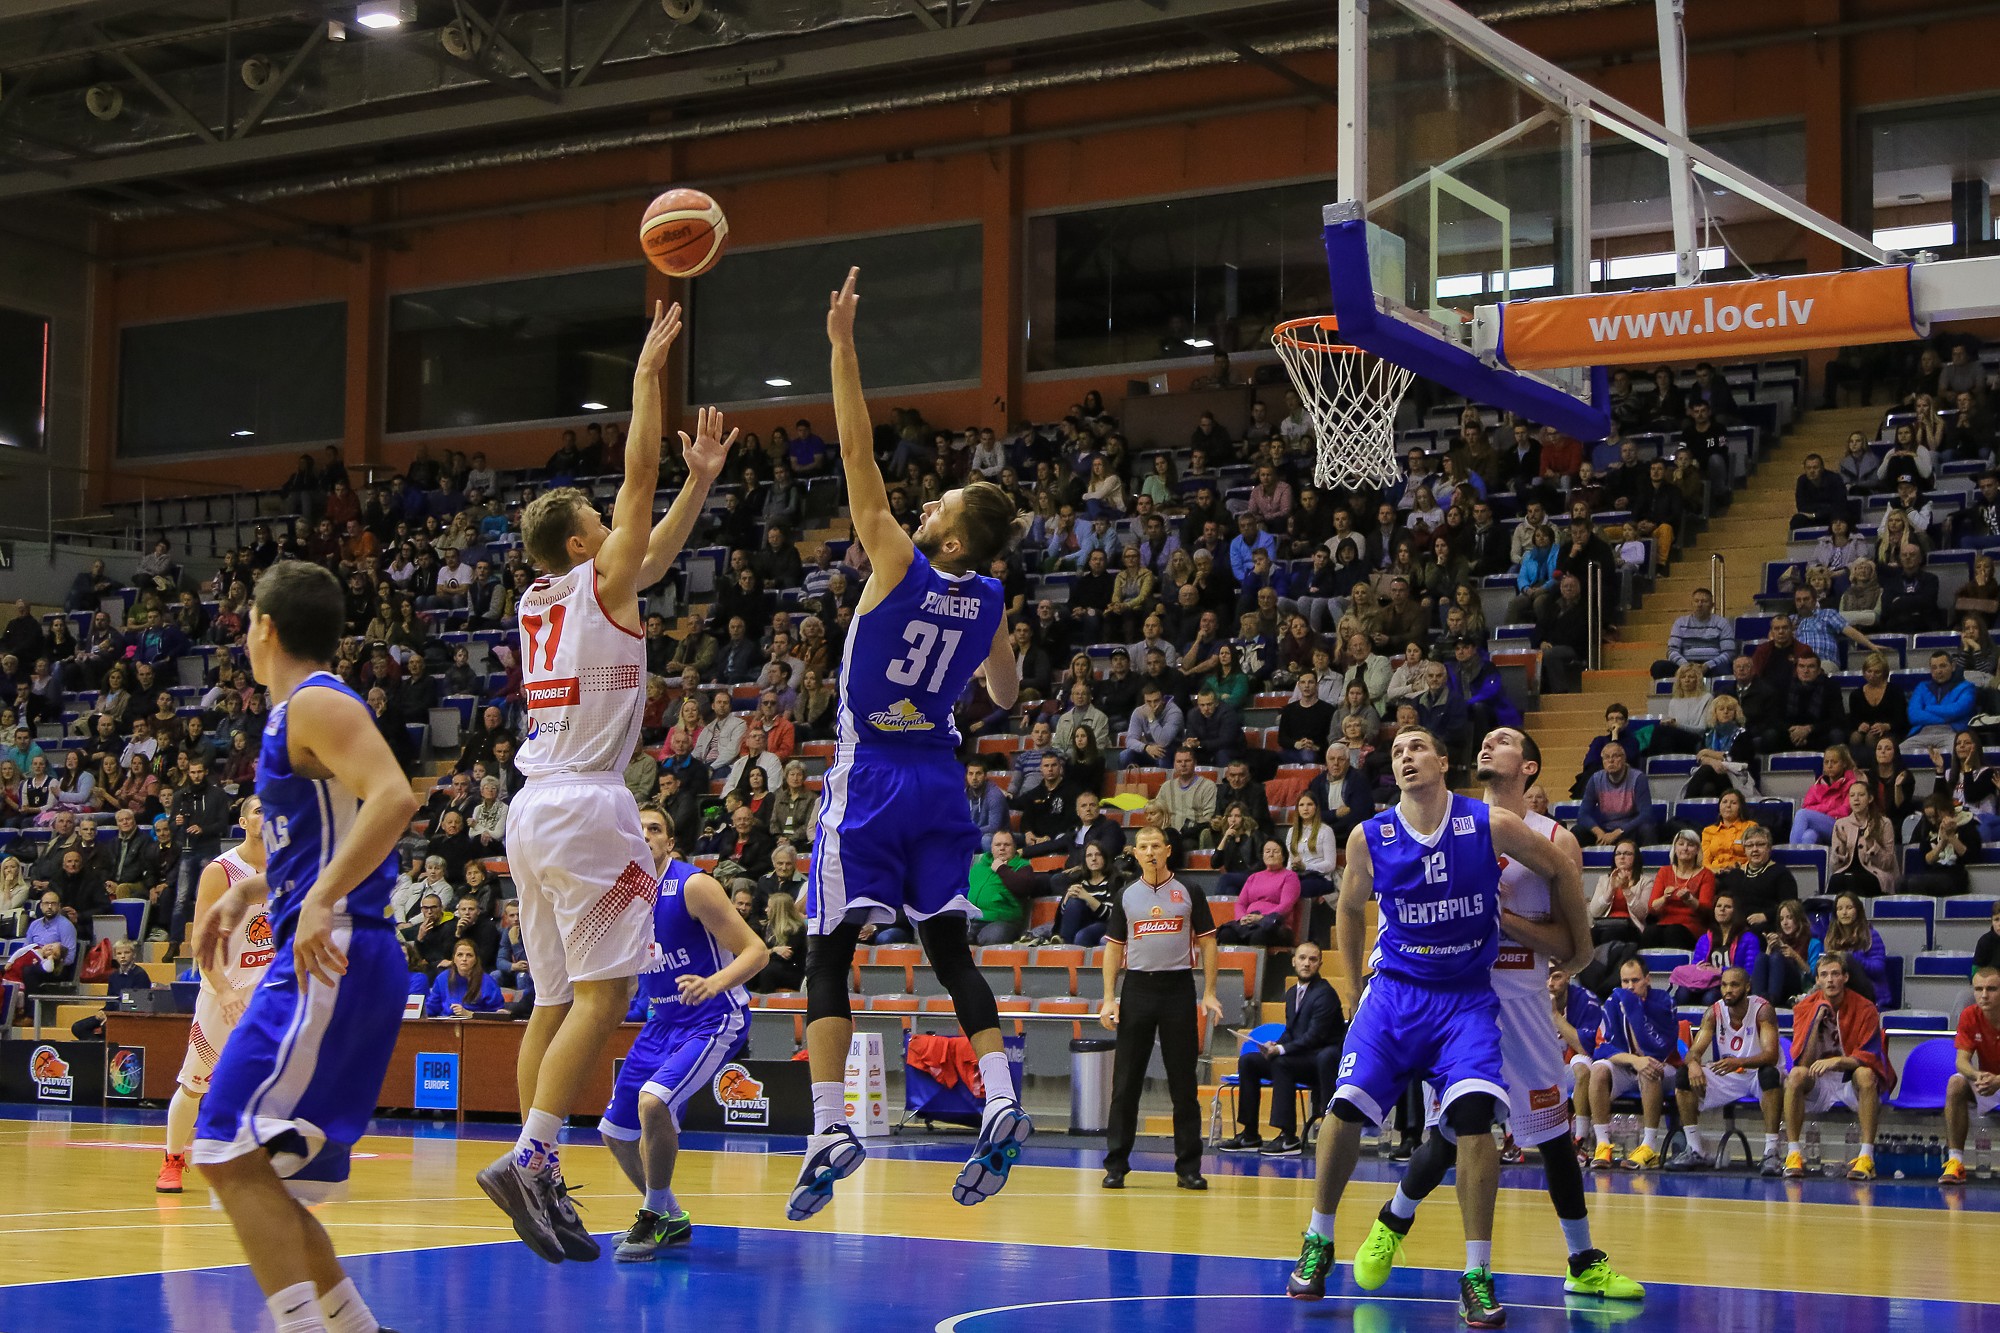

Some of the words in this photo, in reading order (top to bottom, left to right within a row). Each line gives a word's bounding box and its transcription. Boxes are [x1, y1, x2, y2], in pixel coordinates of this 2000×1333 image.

[1588, 290, 1814, 342] www.loc.lv
[886, 619, 963, 694] 31
[530, 686, 571, 701] TRIOBET
[539, 716, 570, 735] pepsi
[1421, 851, 1448, 885] 12
[1397, 893, 1484, 925] VENTSPILS
[1137, 921, 1179, 934] Aldaris
[423, 1061, 451, 1079] FIBA
[41, 1077, 71, 1086] LAUVAS
[424, 1079, 450, 1090] EUROPE
[728, 1099, 767, 1110] LAUVAS
